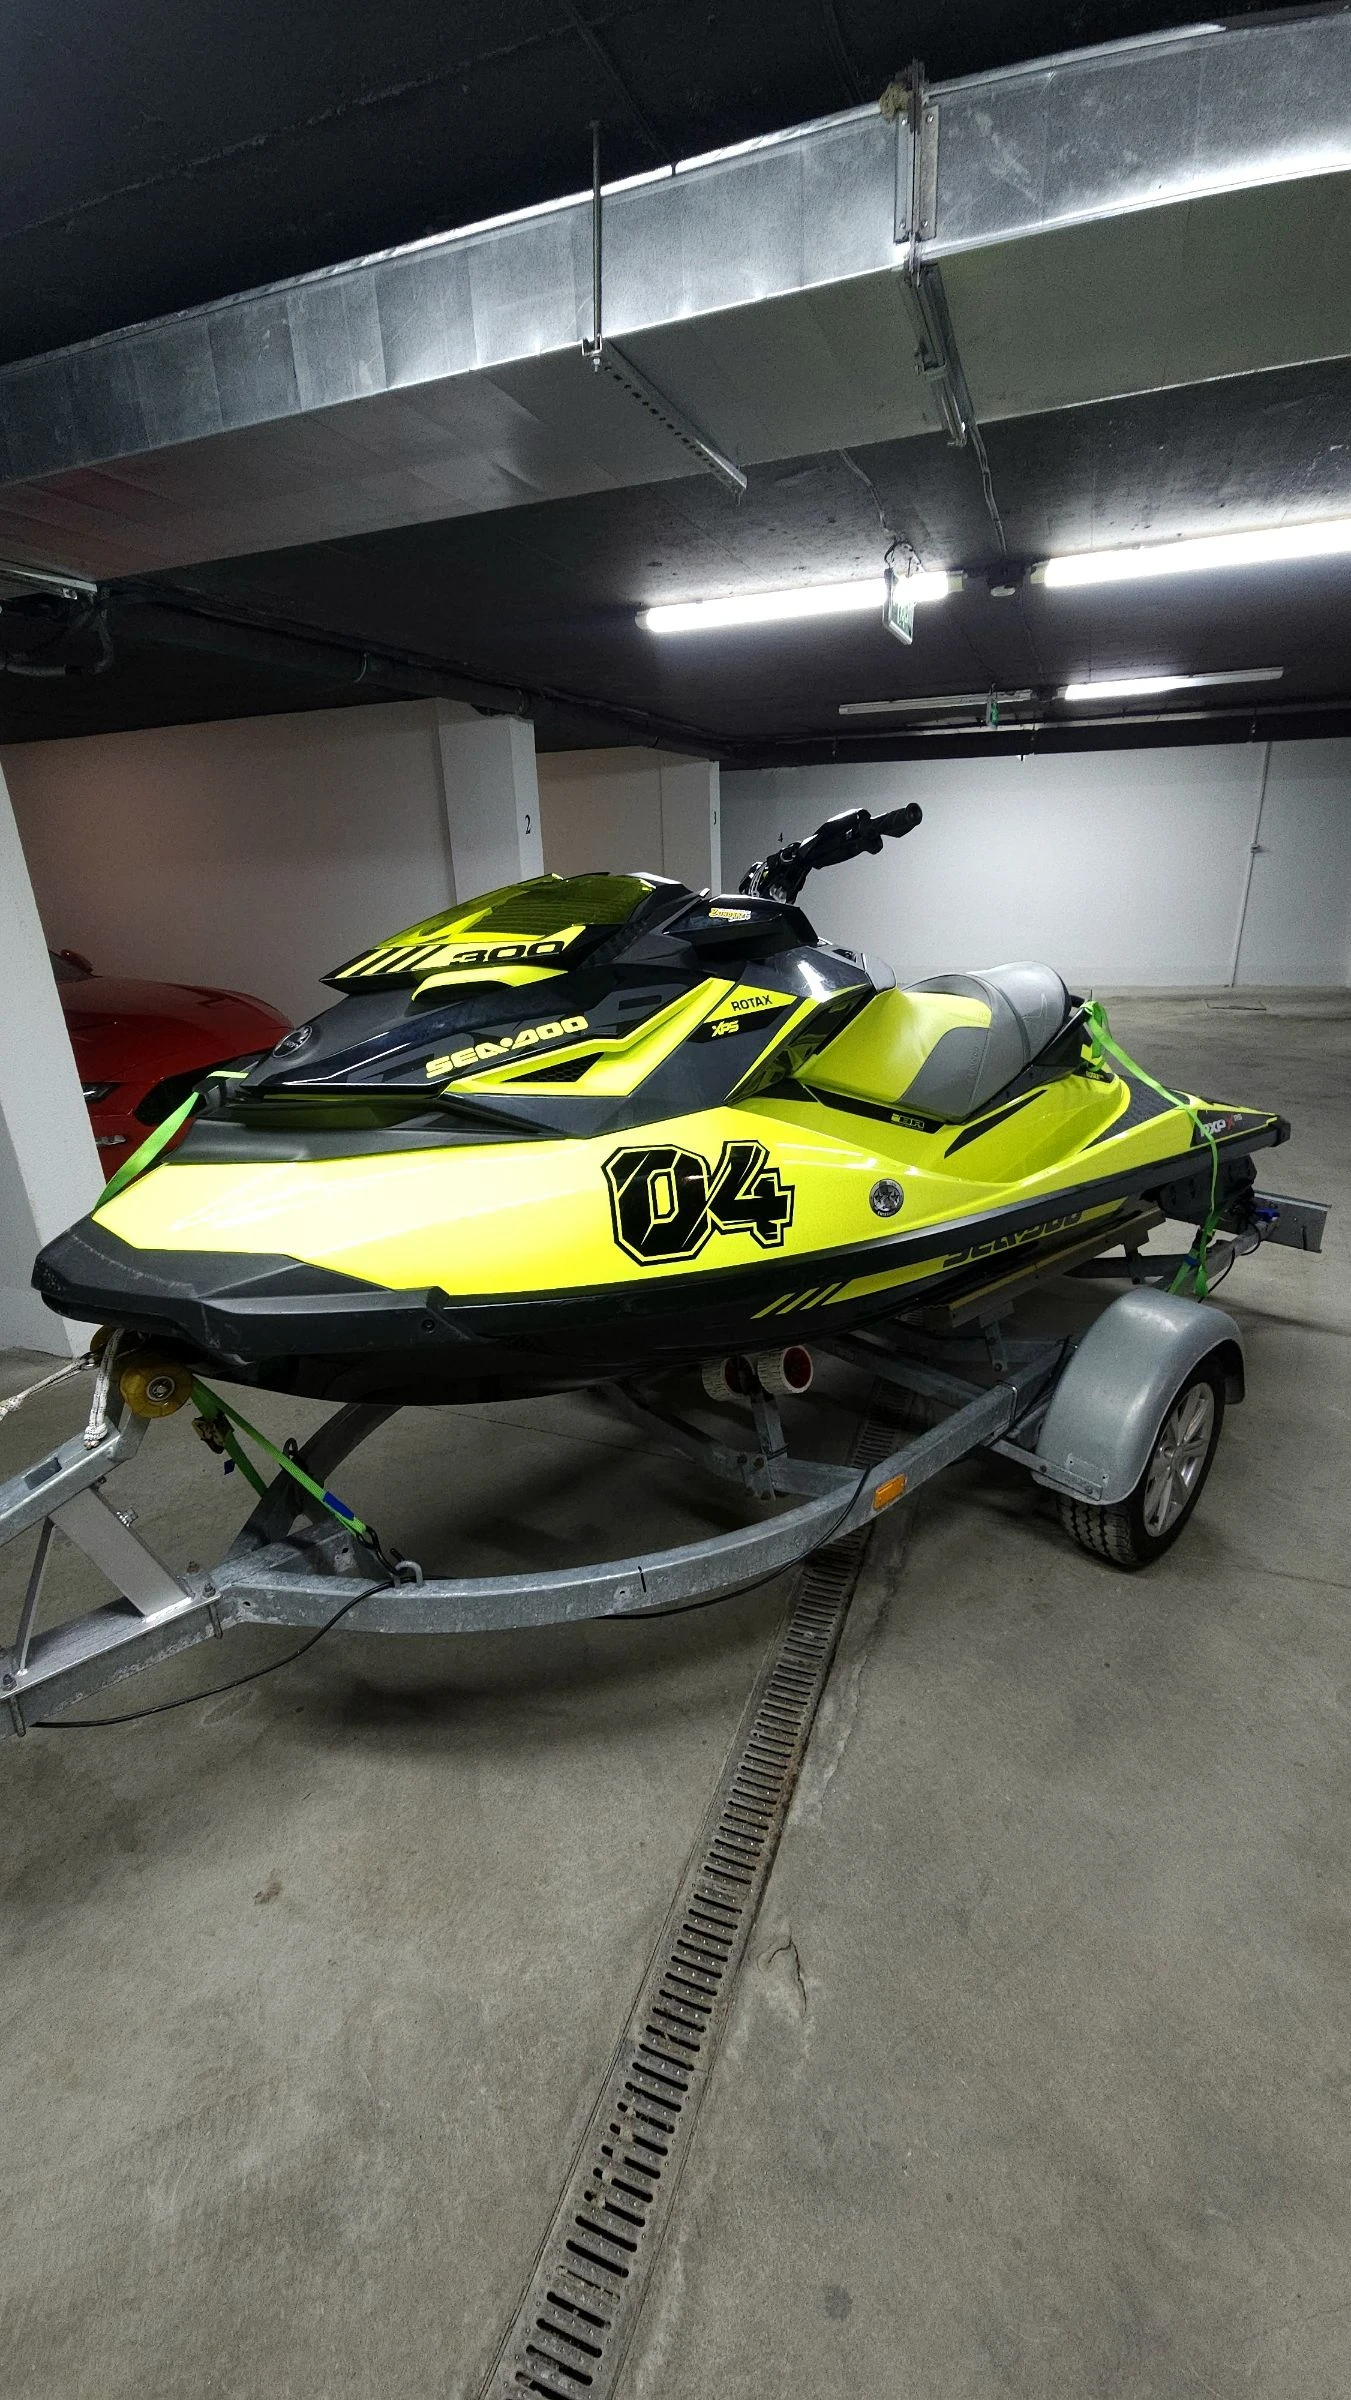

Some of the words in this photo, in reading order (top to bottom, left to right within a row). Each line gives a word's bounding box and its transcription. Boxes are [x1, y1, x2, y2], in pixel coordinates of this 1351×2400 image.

[524, 814, 531, 835] 2
[449, 940, 565, 966] 300
[731, 995, 773, 1011] ROTAX
[711, 1020, 739, 1038] XPS
[601, 1140, 795, 1267] 04
